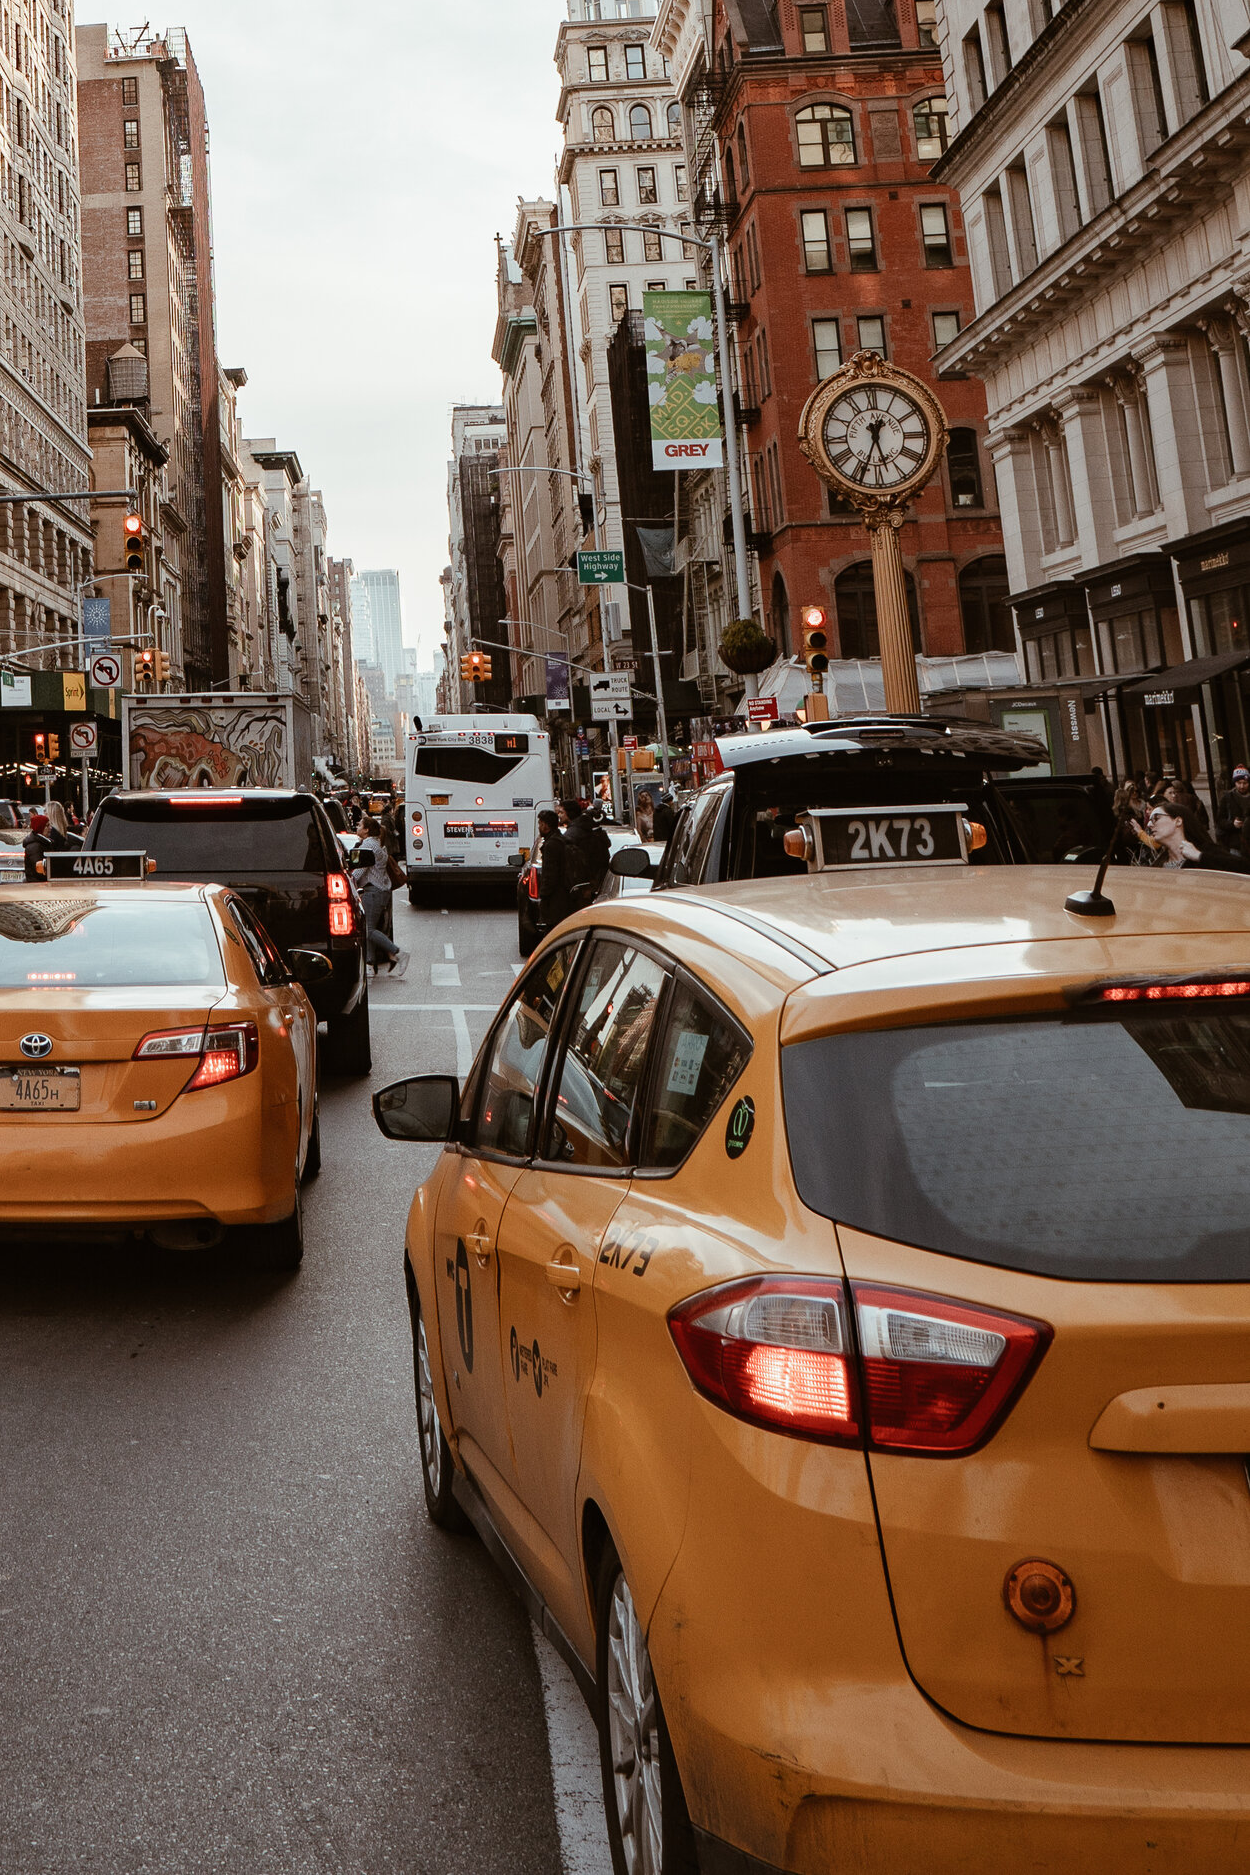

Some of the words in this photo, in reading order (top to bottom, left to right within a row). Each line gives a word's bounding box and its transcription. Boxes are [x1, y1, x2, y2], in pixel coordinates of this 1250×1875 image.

[652, 389, 688, 424] MAD.
[848, 415, 867, 439] FIFTH
[870, 412, 901, 436] AVENUE
[664, 443, 710, 458] GREY
[580, 554, 601, 562] West
[603, 553, 621, 562] Side
[583, 562, 619, 572] Highway
[632, 661, 639, 669] St
[65, 687, 79, 699] Sprint
[611, 685, 629, 693] ROUTE
[593, 706, 611, 714] LOCAL
[468, 735, 494, 745] 3838
[506, 736, 517, 749] M1
[847, 817, 935, 860] 2K73
[72, 856, 114, 875] 4A65
[598, 1226, 660, 1277] 2K73
